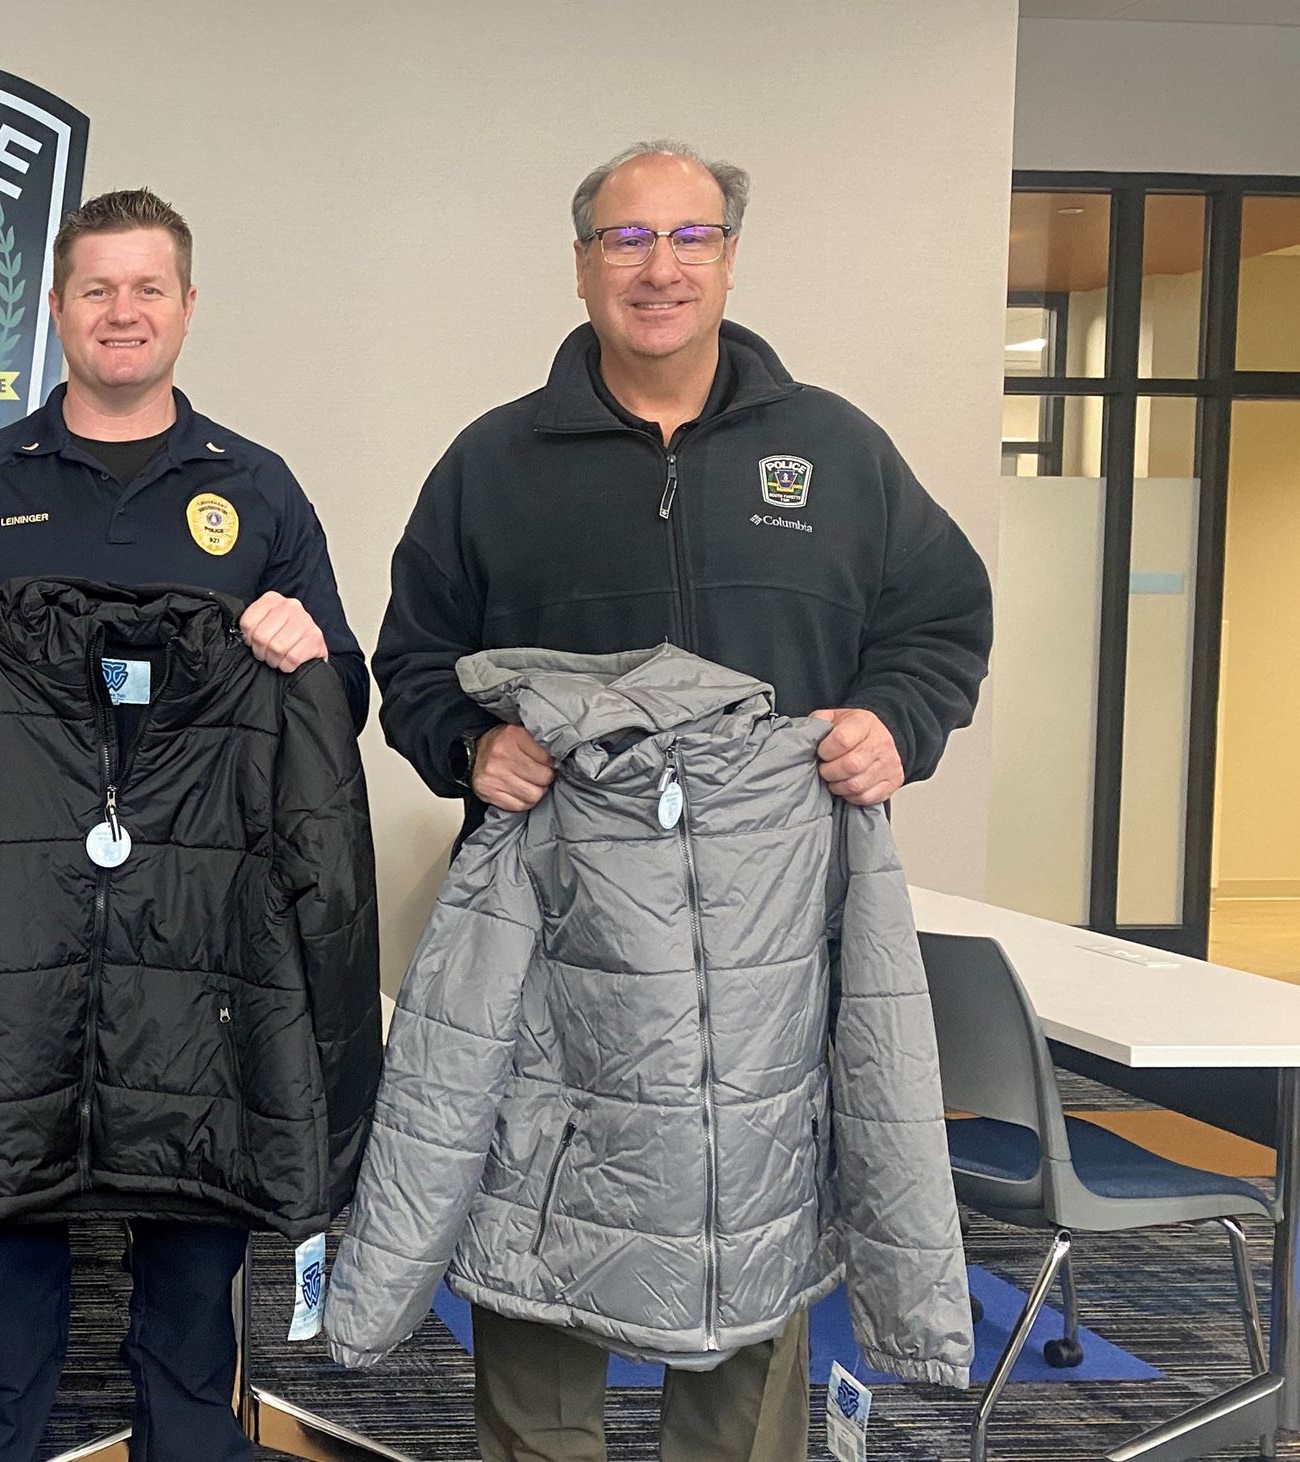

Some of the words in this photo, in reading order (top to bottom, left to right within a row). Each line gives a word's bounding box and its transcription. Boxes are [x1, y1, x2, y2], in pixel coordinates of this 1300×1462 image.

[766, 460, 807, 475] POLICE
[0, 512, 50, 527] LEININGER
[762, 515, 813, 533] Columbia
[204, 525, 224, 534] POLICE
